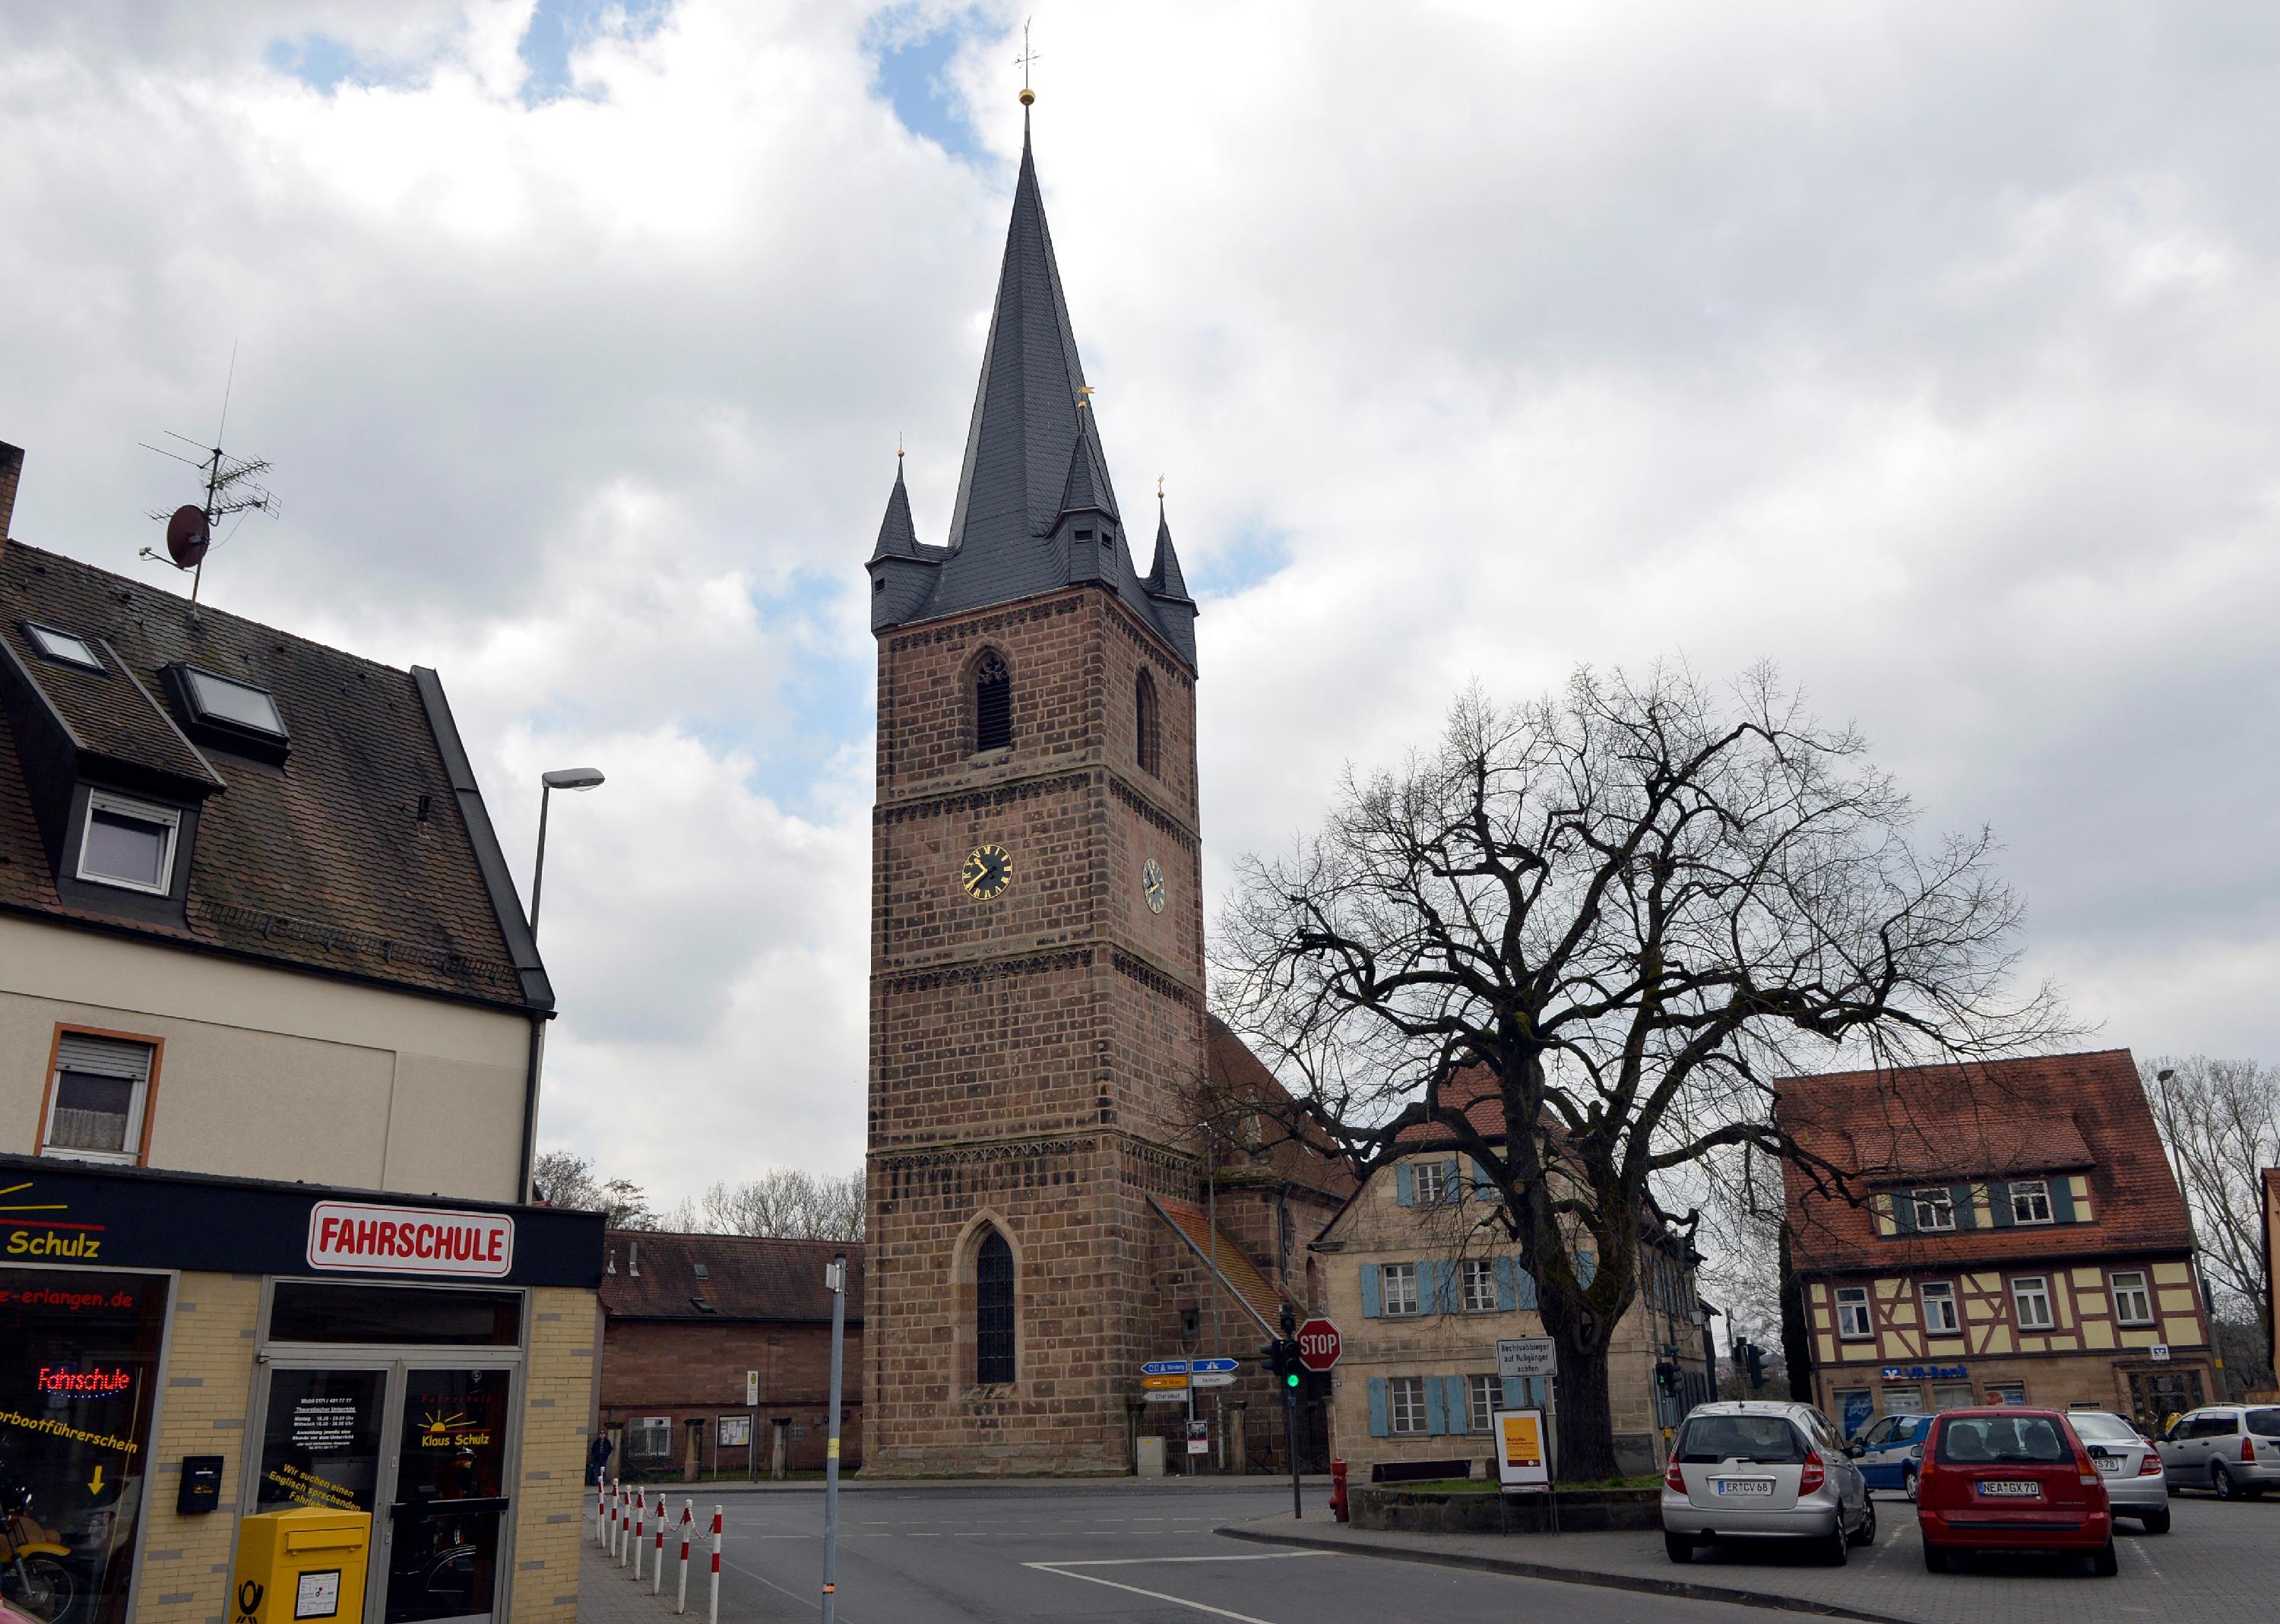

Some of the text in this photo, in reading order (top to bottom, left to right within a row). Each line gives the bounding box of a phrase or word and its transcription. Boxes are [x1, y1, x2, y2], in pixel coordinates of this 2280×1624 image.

[7, 1230, 100, 1258] Schulz
[319, 1217, 504, 1262] FAHRSCHULE
[1300, 1334, 1337, 1355] STOP
[1501, 1343, 1550, 1353] Rechtsabbieger
[1504, 1354, 1514, 1363] auf
[38, 1368, 130, 1390] Fahrschule
[422, 1432, 490, 1447] Klaus Schulz
[268, 1470, 361, 1512] Englisch sprechenden
[283, 1463, 354, 1498] Wir suchen einen
[1726, 1483, 1768, 1492] ER CV 68
[1983, 1483, 2037, 1493] NEA GX 70
